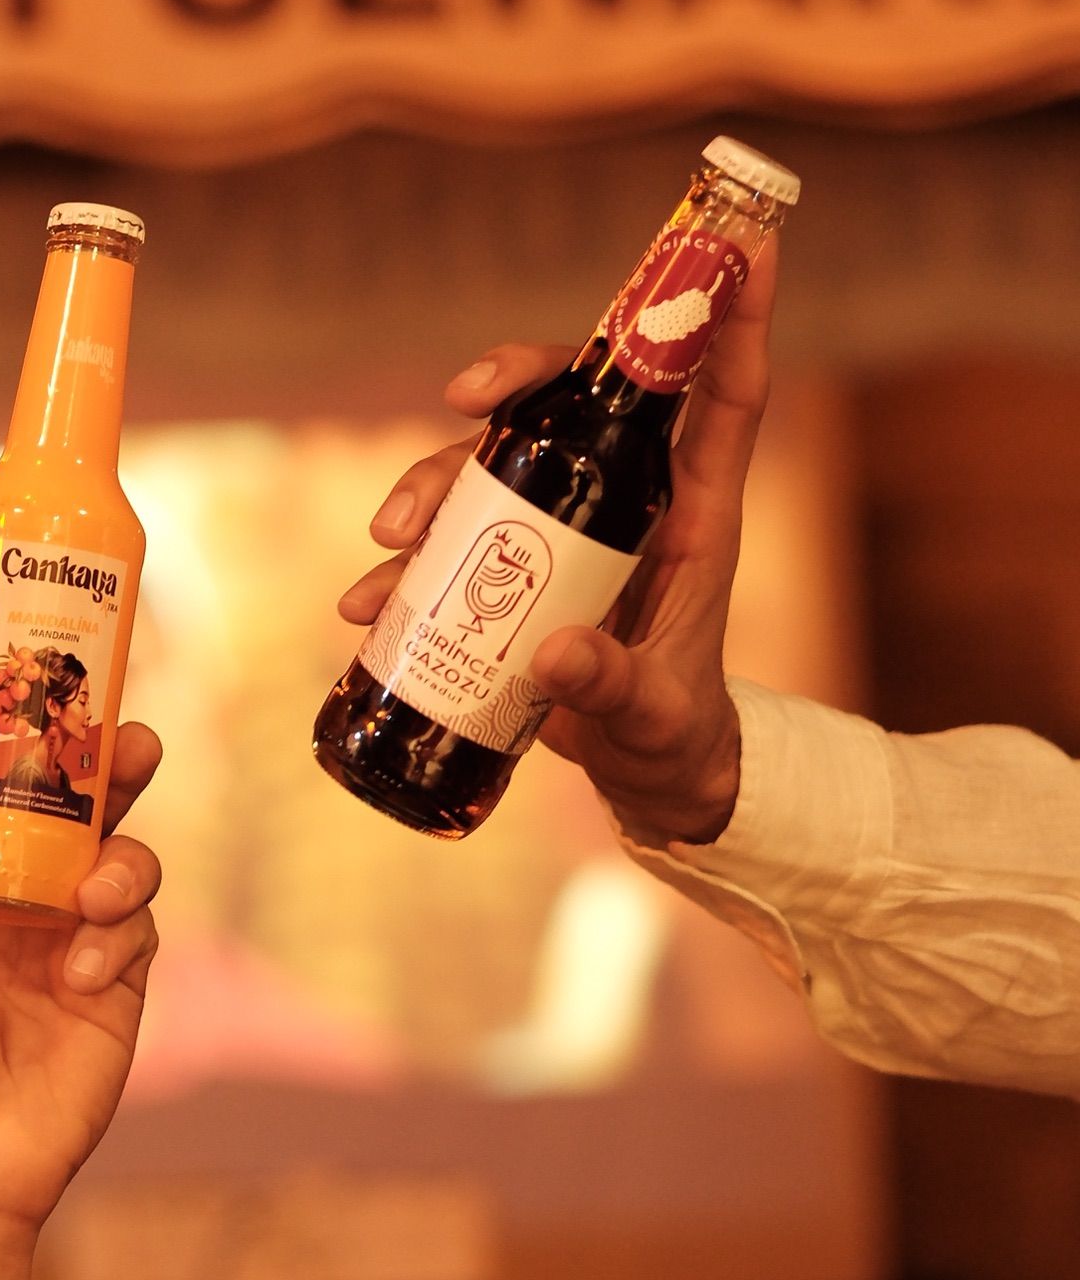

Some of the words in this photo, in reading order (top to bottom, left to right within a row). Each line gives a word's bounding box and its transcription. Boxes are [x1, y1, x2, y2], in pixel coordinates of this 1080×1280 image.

[59, 335, 115, 375] ankaya
[1, 547, 117, 603] Çankaya
[29, 628, 80, 643] MANDARIN
[406, 641, 490, 700] GAZOZU
[408, 665, 462, 704] Karadut
